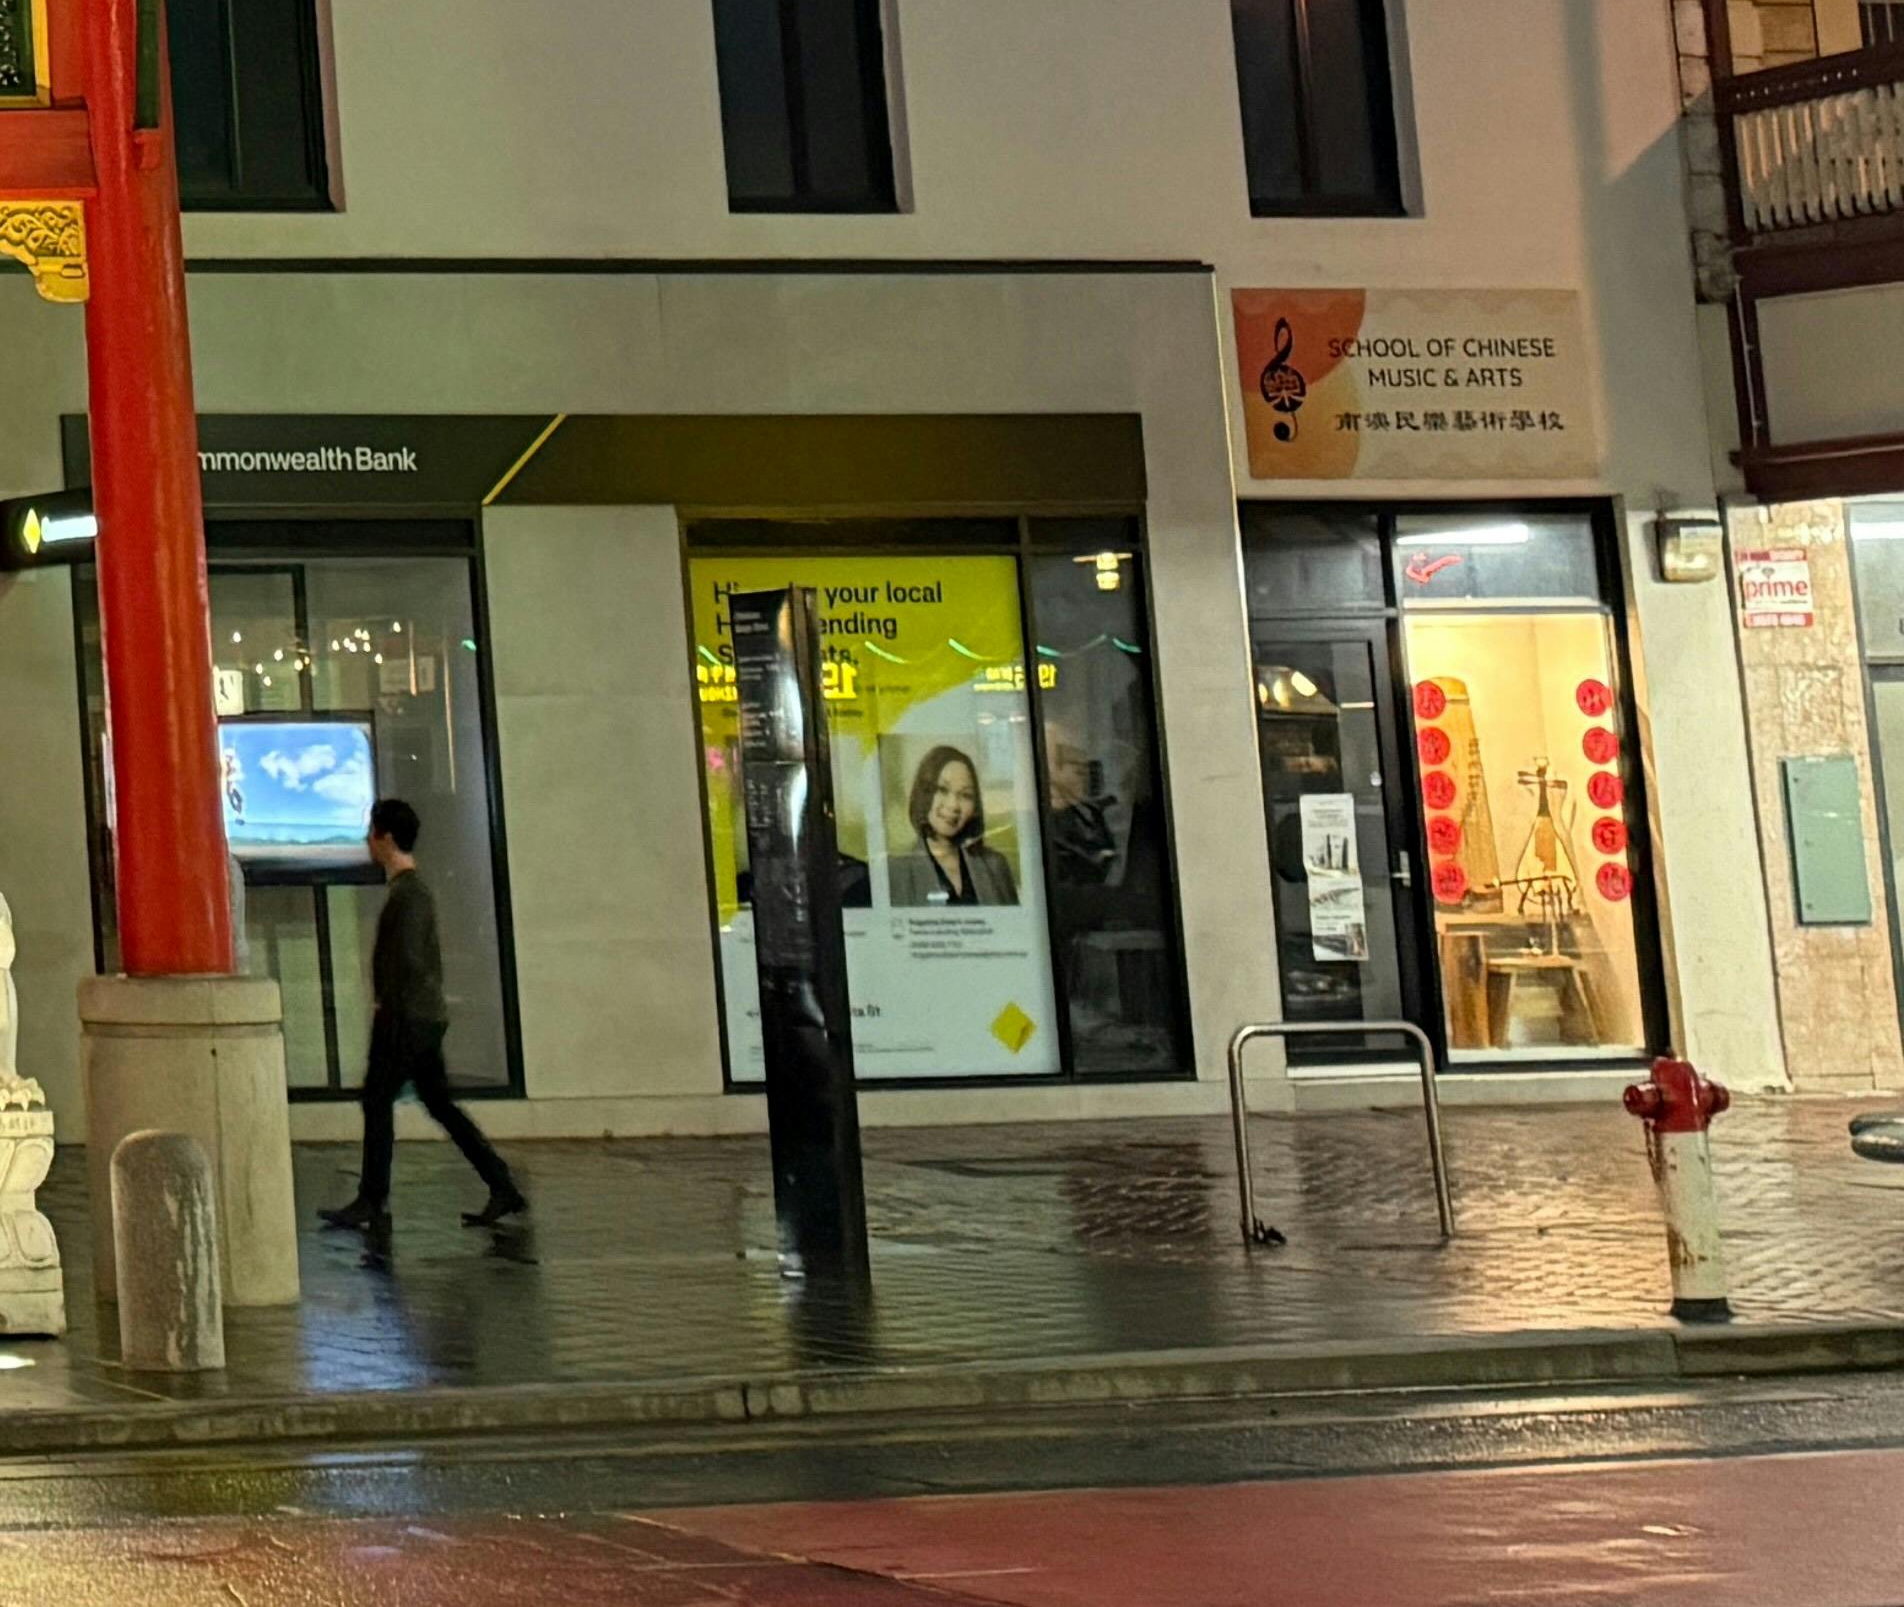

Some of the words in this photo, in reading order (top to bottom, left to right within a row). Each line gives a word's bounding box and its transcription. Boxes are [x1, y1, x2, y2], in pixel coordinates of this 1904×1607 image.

[1328, 337, 1421, 358] SCHOOL
[1426, 337, 1457, 357] OF
[1462, 336, 1556, 358] CHINESE
[1368, 368, 1438, 388] MUSIC
[1444, 368, 1459, 387] &
[1465, 368, 1523, 388] ARTS
[825, 584, 880, 609] your
[886, 581, 943, 604] local
[818, 612, 898, 640] ending
